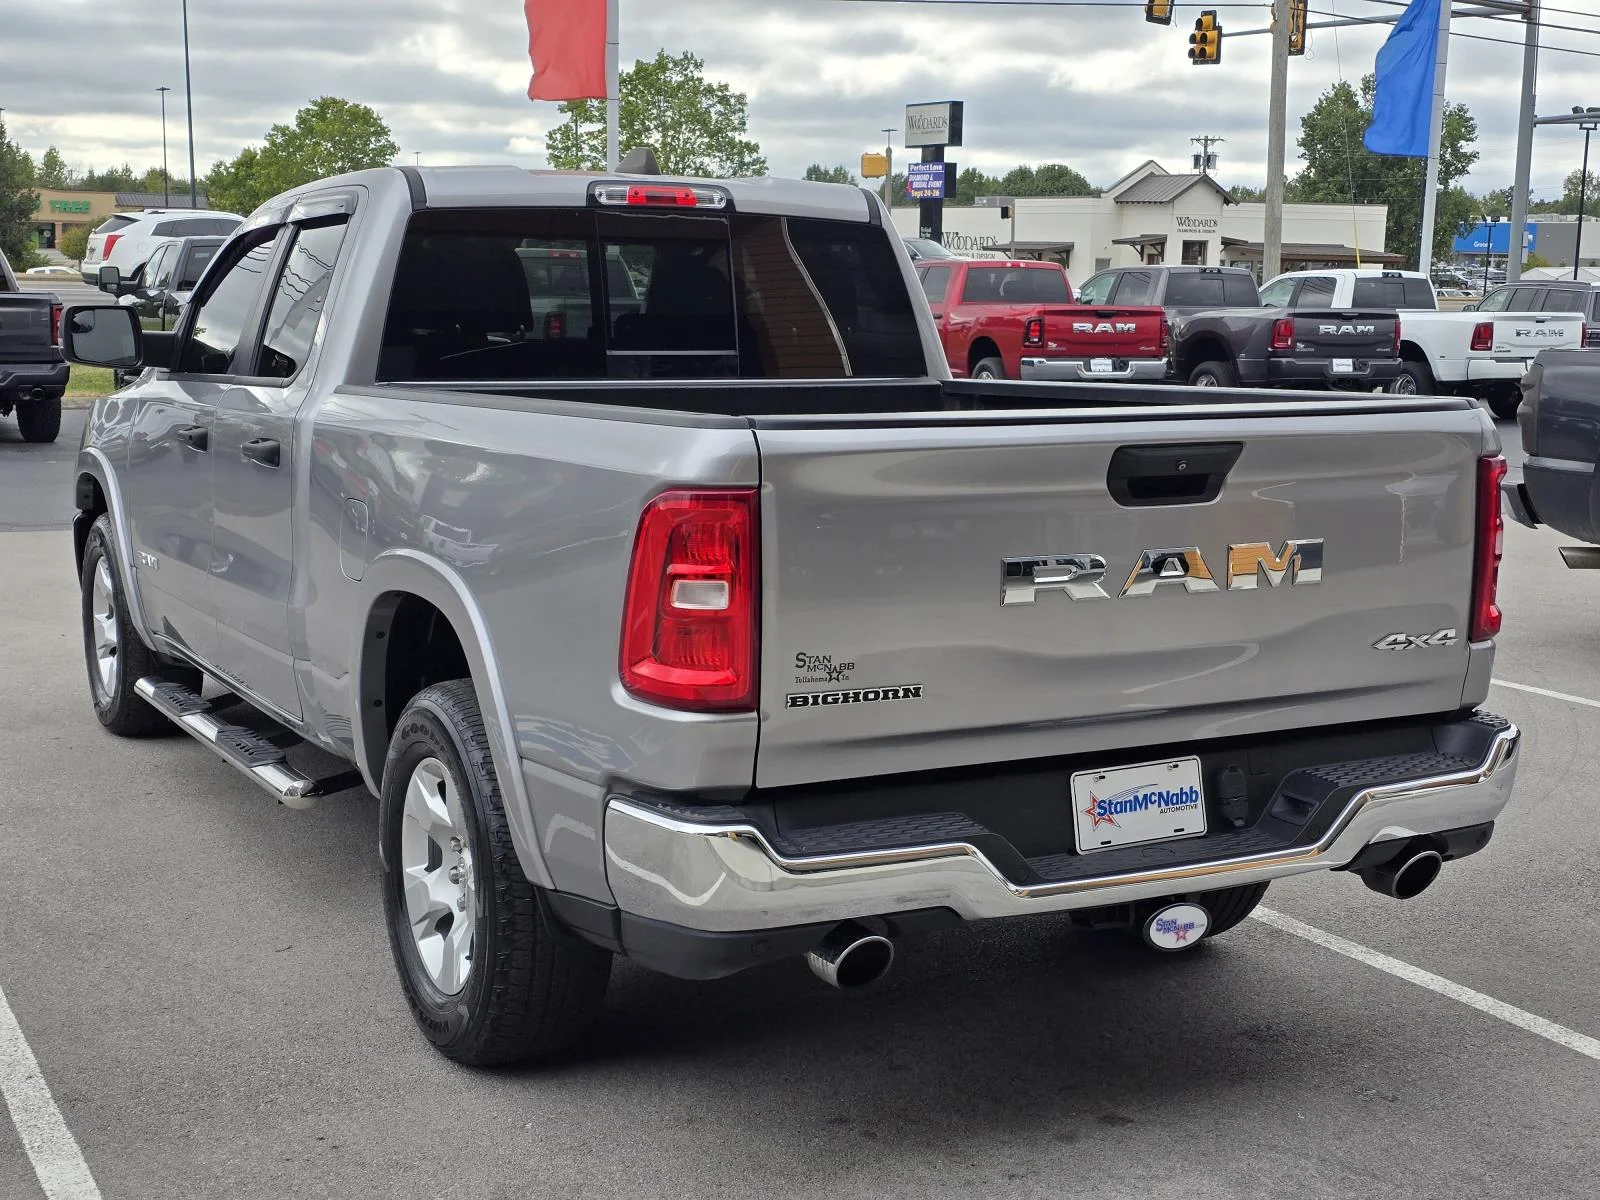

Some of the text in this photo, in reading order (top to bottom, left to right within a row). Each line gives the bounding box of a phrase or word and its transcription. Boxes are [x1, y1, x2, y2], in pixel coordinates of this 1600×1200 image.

[911, 190, 923, 198] Sept
[1072, 323, 1137, 334] RAM
[1318, 325, 1375, 336] RAM
[1515, 328, 1565, 338] RAM
[1000, 537, 1325, 607] RAM
[1372, 628, 1459, 652] 4x4
[786, 684, 923, 709] BIGHORN
[1160, 803, 1199, 815] AUTOMOTIVE
